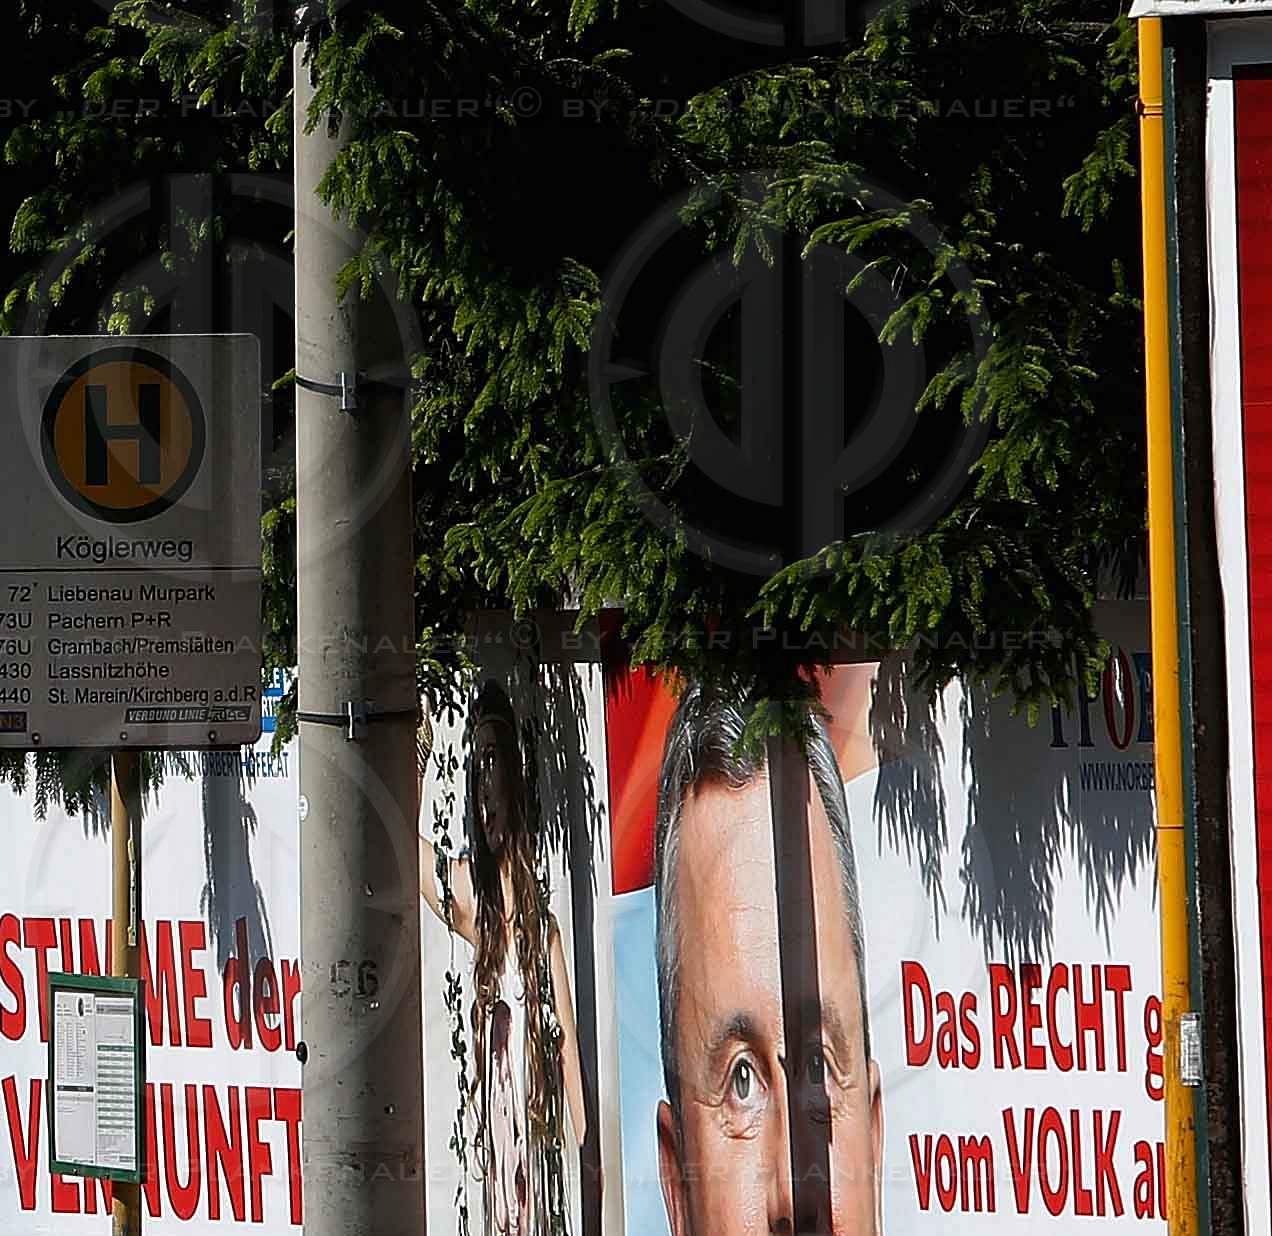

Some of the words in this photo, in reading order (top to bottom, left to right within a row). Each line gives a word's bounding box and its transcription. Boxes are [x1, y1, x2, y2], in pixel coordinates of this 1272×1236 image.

[84, 383, 161, 486] H
[56, 536, 194, 562] Köglerweg
[47, 584, 133, 602] Liebenau
[139, 584, 216, 605] Murpark
[47, 612, 125, 630] Pachern
[131, 611, 172, 629] P+R
[47, 636, 234, 656] Grambach/Premstätten
[47, 662, 170, 680] Lassnitzhöhe
[47, 687, 68, 705] St.
[74, 684, 209, 706] Marein/Kirchberg
[222, 916, 304, 1053] der
[901, 960, 981, 1070] Das
[989, 962, 1133, 1073] RECHT
[909, 1133, 996, 1213] vom
[1002, 1106, 1125, 1218] VOLK
